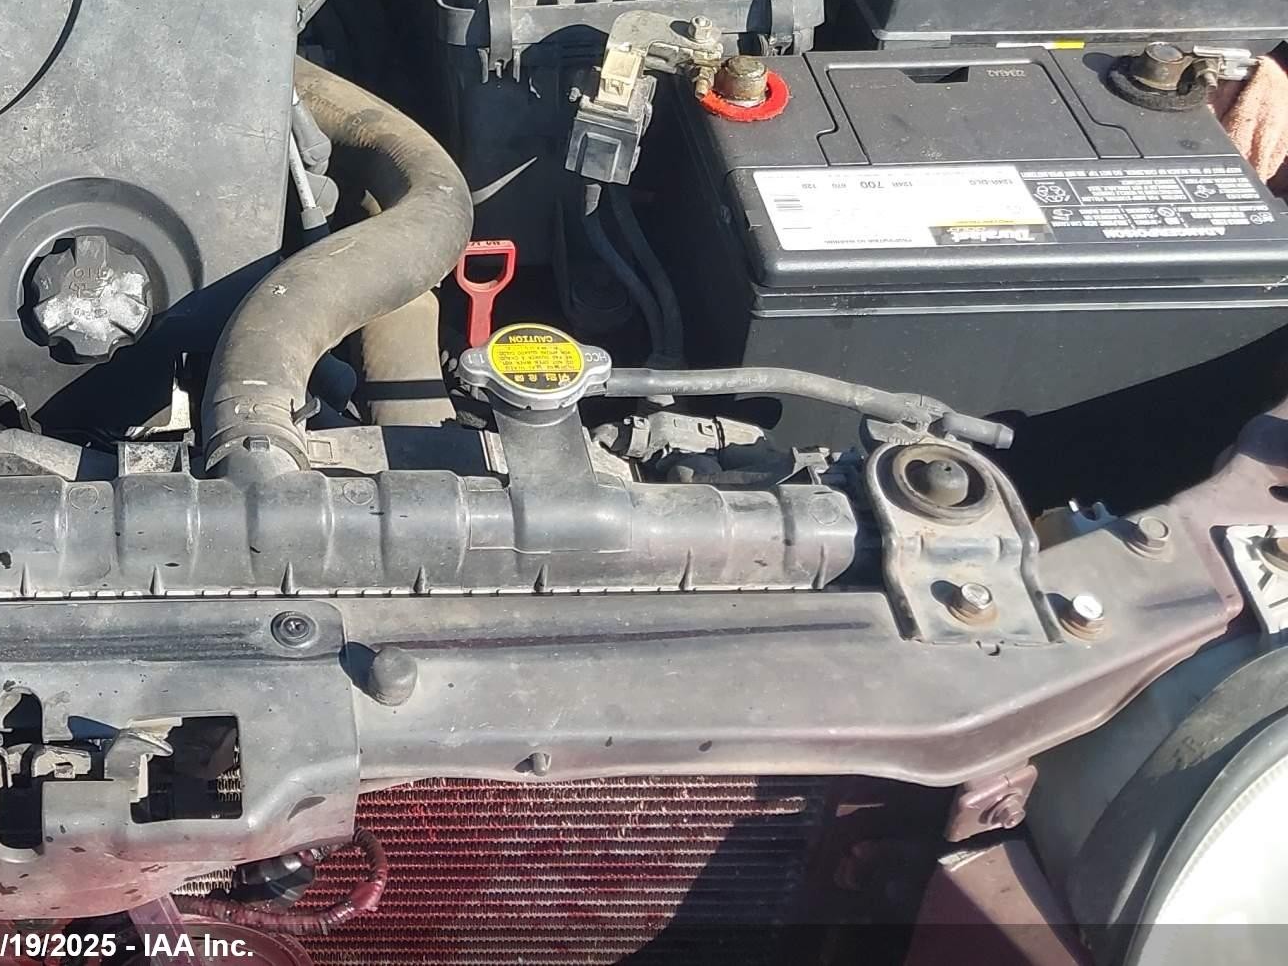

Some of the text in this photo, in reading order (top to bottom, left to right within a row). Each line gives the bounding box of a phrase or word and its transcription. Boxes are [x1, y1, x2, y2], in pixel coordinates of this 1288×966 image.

[859, 180, 886, 189] 700
[508, 335, 553, 343] CAUTION
[584, 352, 607, 362] HCC
